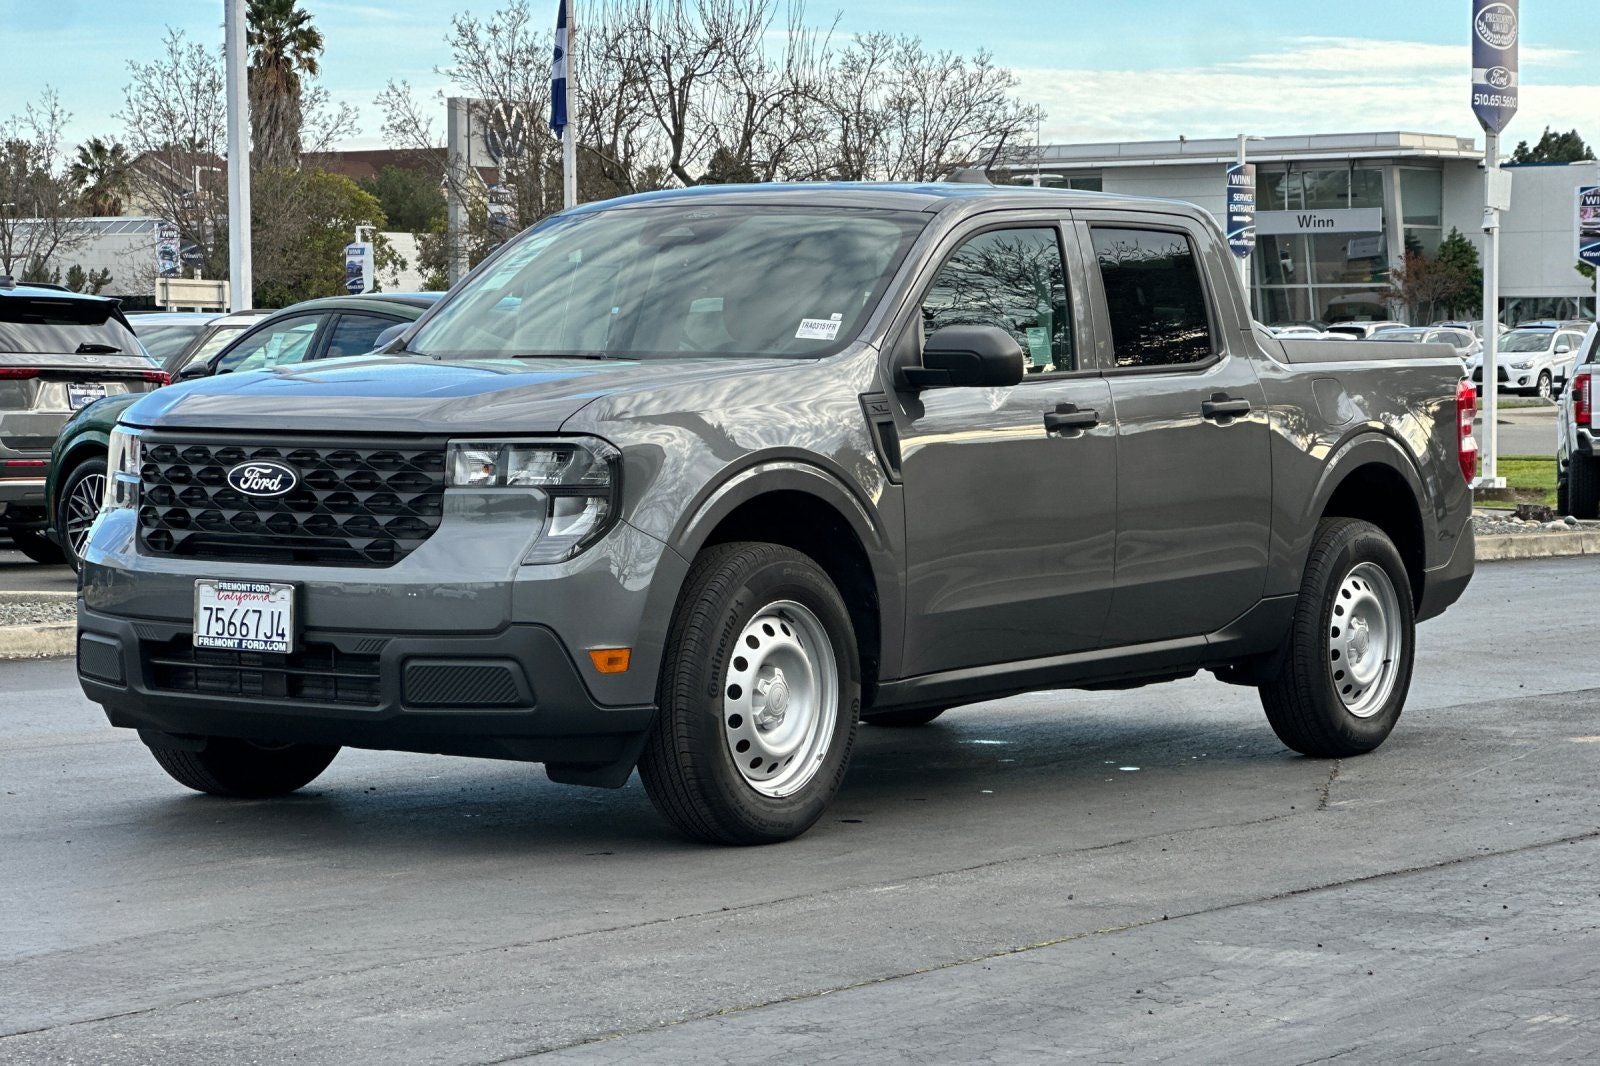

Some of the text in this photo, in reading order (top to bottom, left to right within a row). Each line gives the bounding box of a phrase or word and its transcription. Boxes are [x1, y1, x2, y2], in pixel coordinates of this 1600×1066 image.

[1490, 69, 1508, 86] Ford
[1232, 174, 1251, 185] WINN
[1233, 193, 1253, 202] SERVICE
[1229, 204, 1255, 213] ENTRANCE
[1297, 214, 1334, 228] Winn
[240, 466, 283, 491] Ford
[218, 582, 270, 593] FREMONT FORD
[217, 590, 275, 605] California
[203, 606, 286, 640] 75667J4
[198, 637, 286, 652] FREMONT FORD.COM
[708, 608, 739, 698] Continental
